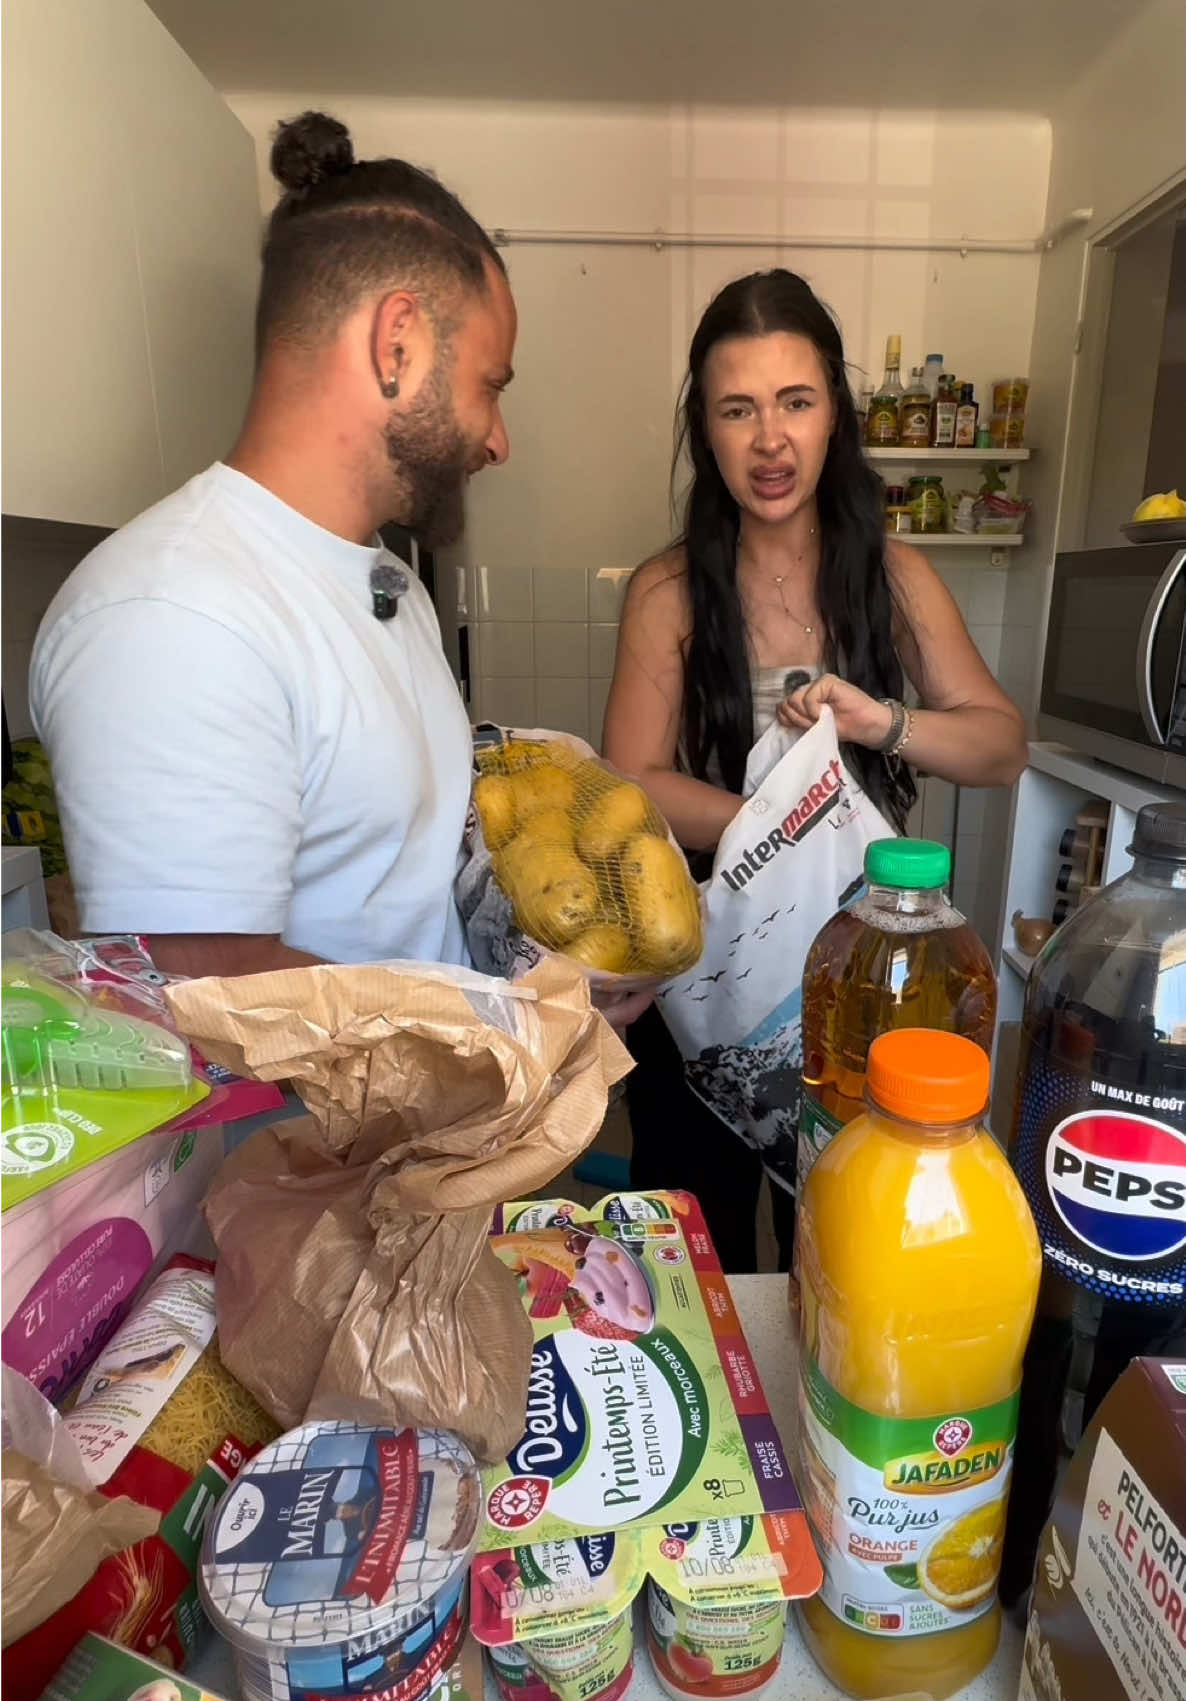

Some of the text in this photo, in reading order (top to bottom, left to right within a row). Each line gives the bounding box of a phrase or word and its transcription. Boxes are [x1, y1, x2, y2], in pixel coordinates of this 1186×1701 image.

[1091, 1080, 1185, 1112] UN MAX DE GOÛT
[1096, 1269, 1184, 1294] SUCRES
[22, 1302, 49, 1338] 12
[79, 1275, 124, 1330] DOUBLE
[650, 1338, 698, 1404] morceaux
[728, 1350, 748, 1399] RHUBARBE
[738, 1354, 757, 1392] GRIOTTE
[583, 1342, 642, 1507] Printemps-Été
[629, 1355, 666, 1477] ÉDITION LIMITÉE
[686, 1405, 703, 1438] Avec
[754, 1441, 775, 1480] FRAISE
[765, 1441, 784, 1478] CASSIS
[892, 1449, 1001, 1485] JAFADEN
[488, 1483, 512, 1526] MARQUE
[702, 1478, 723, 1500] x8
[873, 1498, 910, 1510] 100%
[230, 1497, 251, 1532] Ouvrir
[247, 1506, 257, 1521] ici
[277, 1506, 294, 1522] LE
[281, 1470, 336, 1559] MARIN
[848, 1496, 940, 1534] Pur jus
[1097, 1498, 1113, 1521] et
[1114, 1511, 1139, 1563] LE
[1117, 1469, 1186, 1592] PELFORT
[849, 1533, 919, 1552] ORANGE
[682, 1556, 735, 1577] 10/08
[1129, 1577, 1154, 1629] longue
[723, 1655, 761, 1670] 125g
[579, 1669, 615, 1698] 125g
